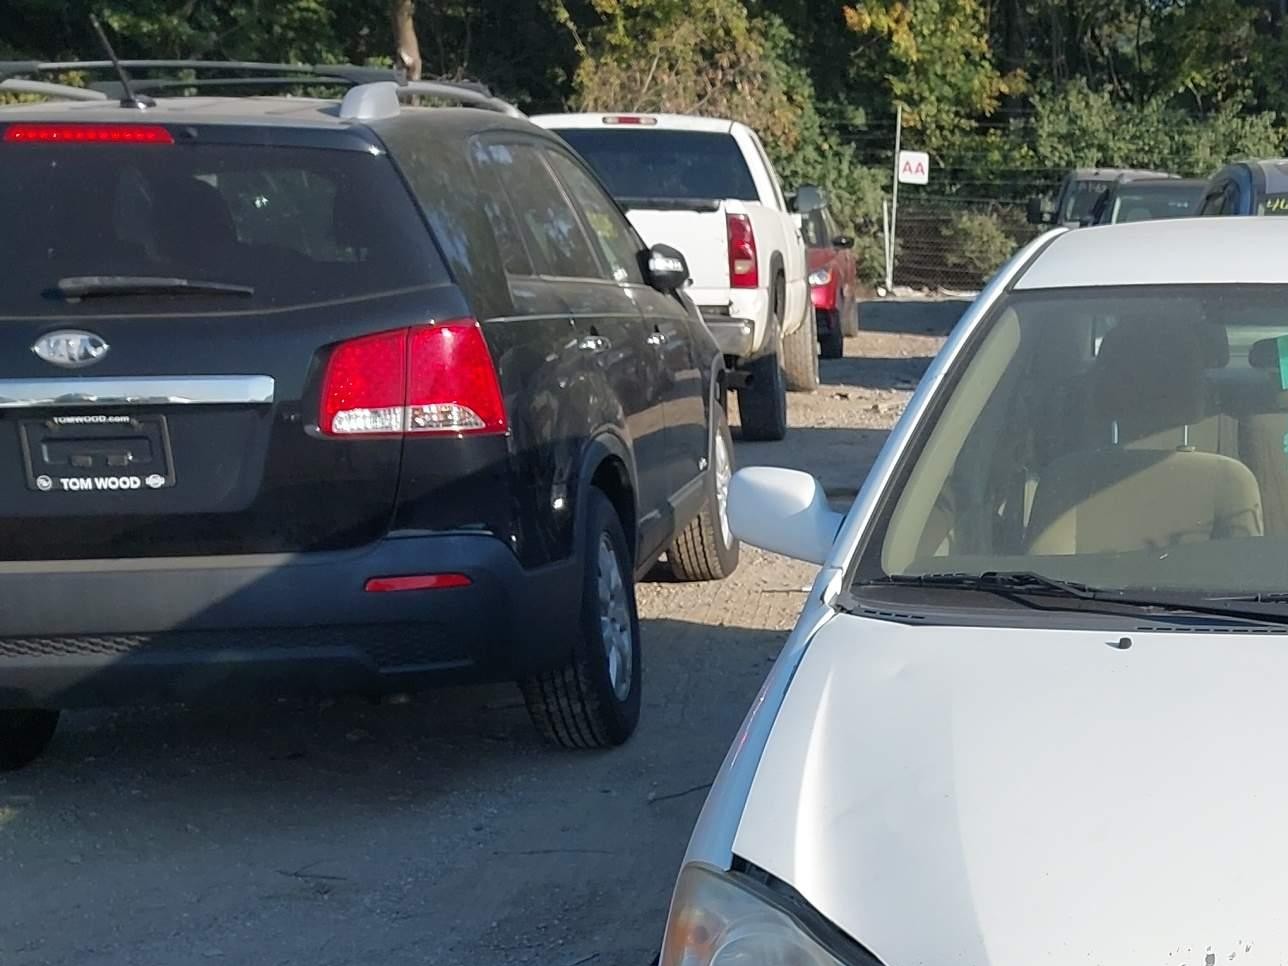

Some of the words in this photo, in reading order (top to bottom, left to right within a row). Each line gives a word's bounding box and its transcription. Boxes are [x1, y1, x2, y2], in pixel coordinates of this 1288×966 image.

[902, 161, 925, 175] AA
[60, 477, 92, 490] TOM
[94, 476, 141, 489] WOOD
